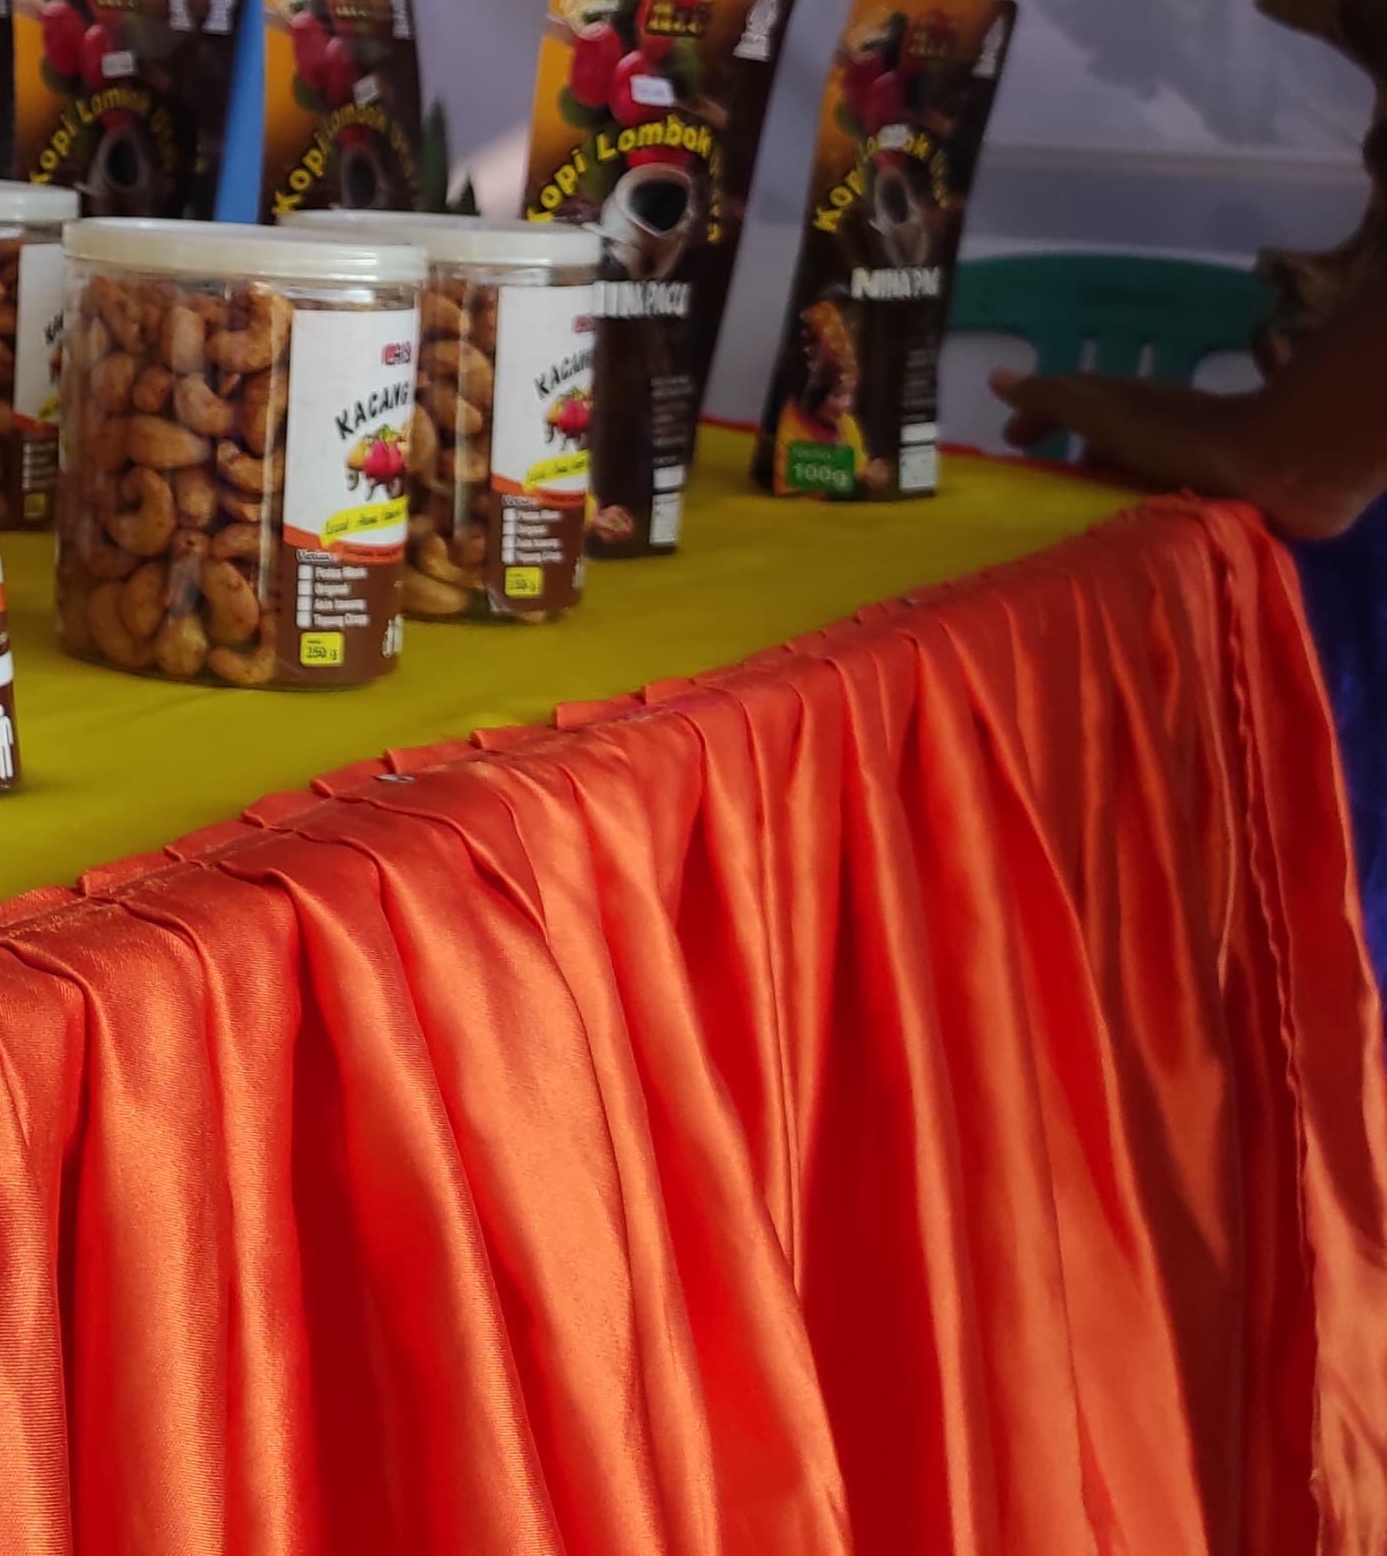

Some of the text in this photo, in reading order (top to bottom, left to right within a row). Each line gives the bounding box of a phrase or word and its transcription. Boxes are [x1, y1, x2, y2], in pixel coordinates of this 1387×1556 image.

[596, 111, 714, 161] Lombok
[533, 348, 593, 401] KACA
[334, 381, 409, 441] KACANG
[791, 462, 848, 491] 100g
